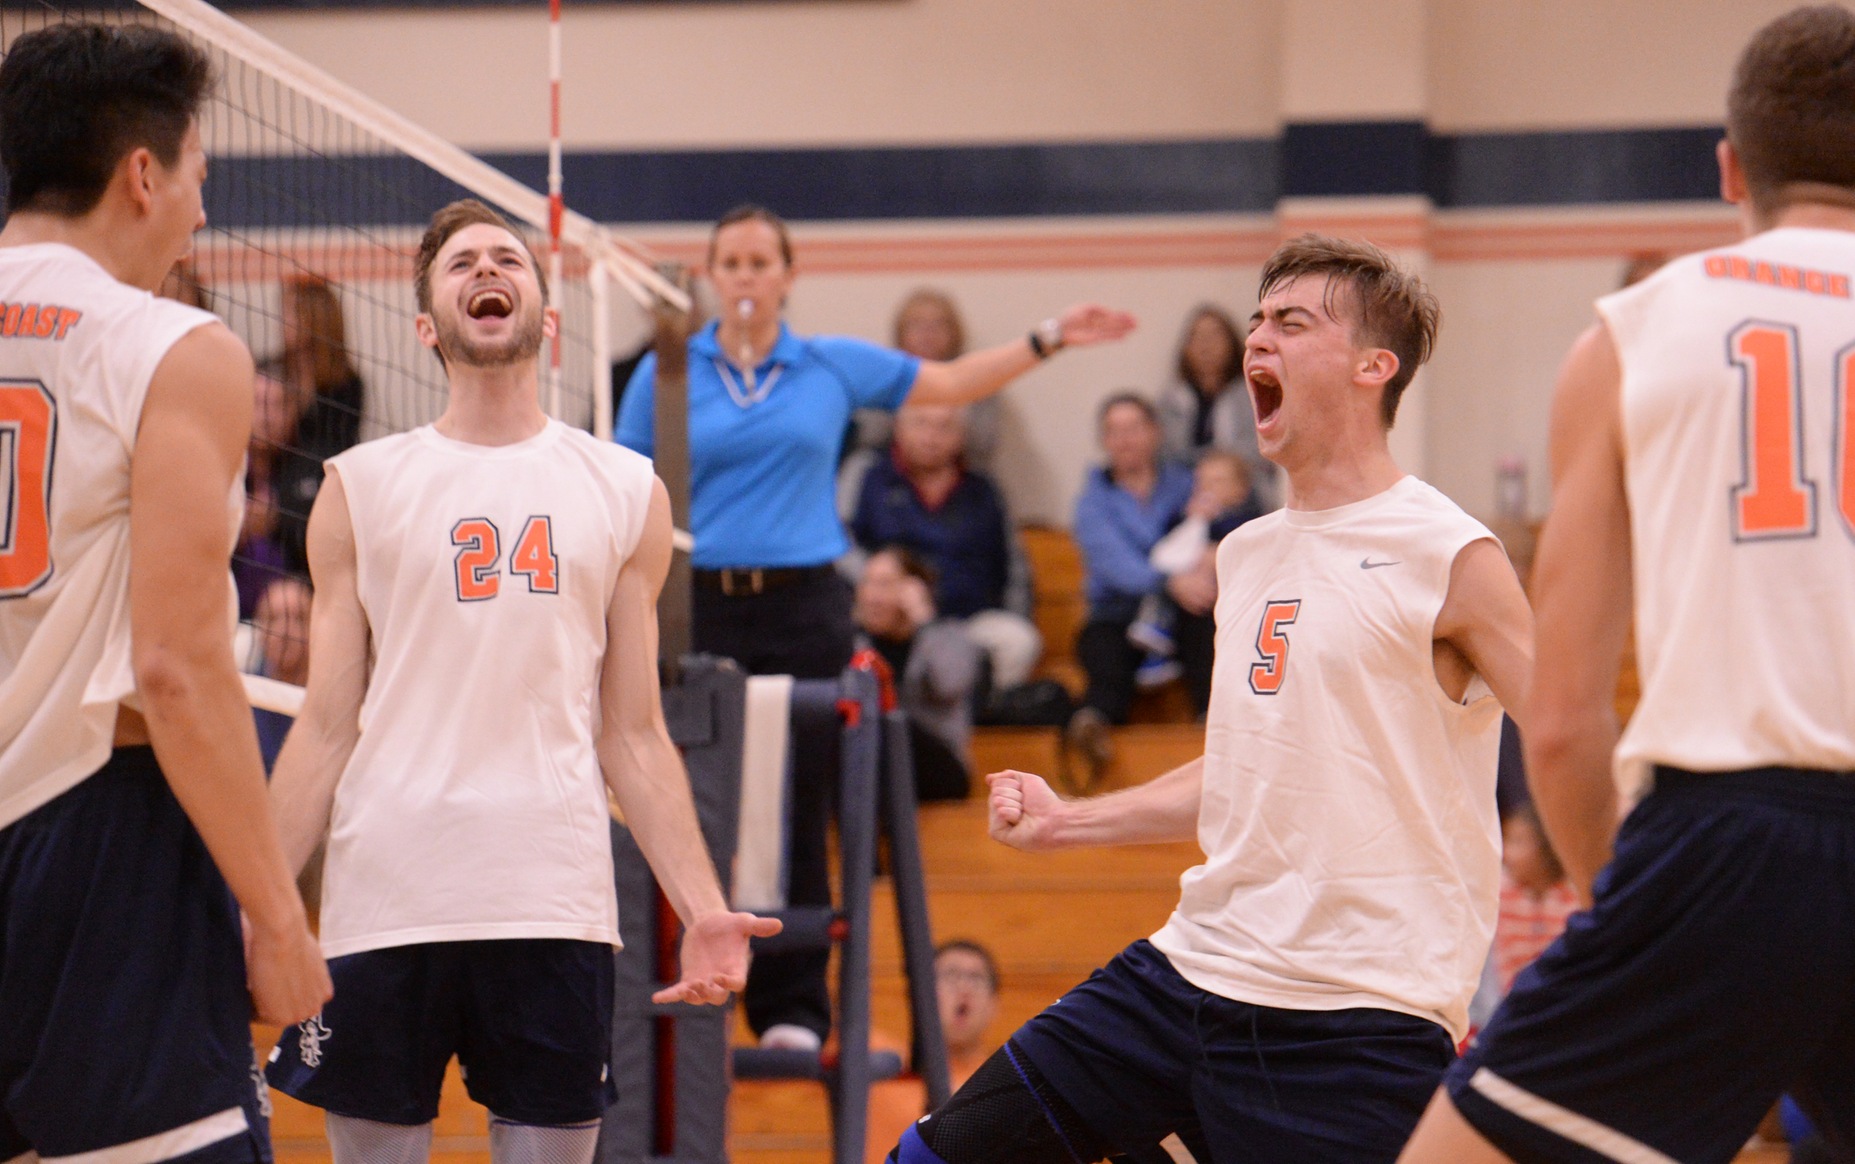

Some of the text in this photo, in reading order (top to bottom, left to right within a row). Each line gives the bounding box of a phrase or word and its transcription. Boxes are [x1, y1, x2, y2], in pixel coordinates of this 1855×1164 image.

[1704, 254, 1853, 300] ORANGE
[1726, 318, 1855, 544] 1
[451, 515, 559, 602] 24
[1248, 599, 1301, 696] 5
